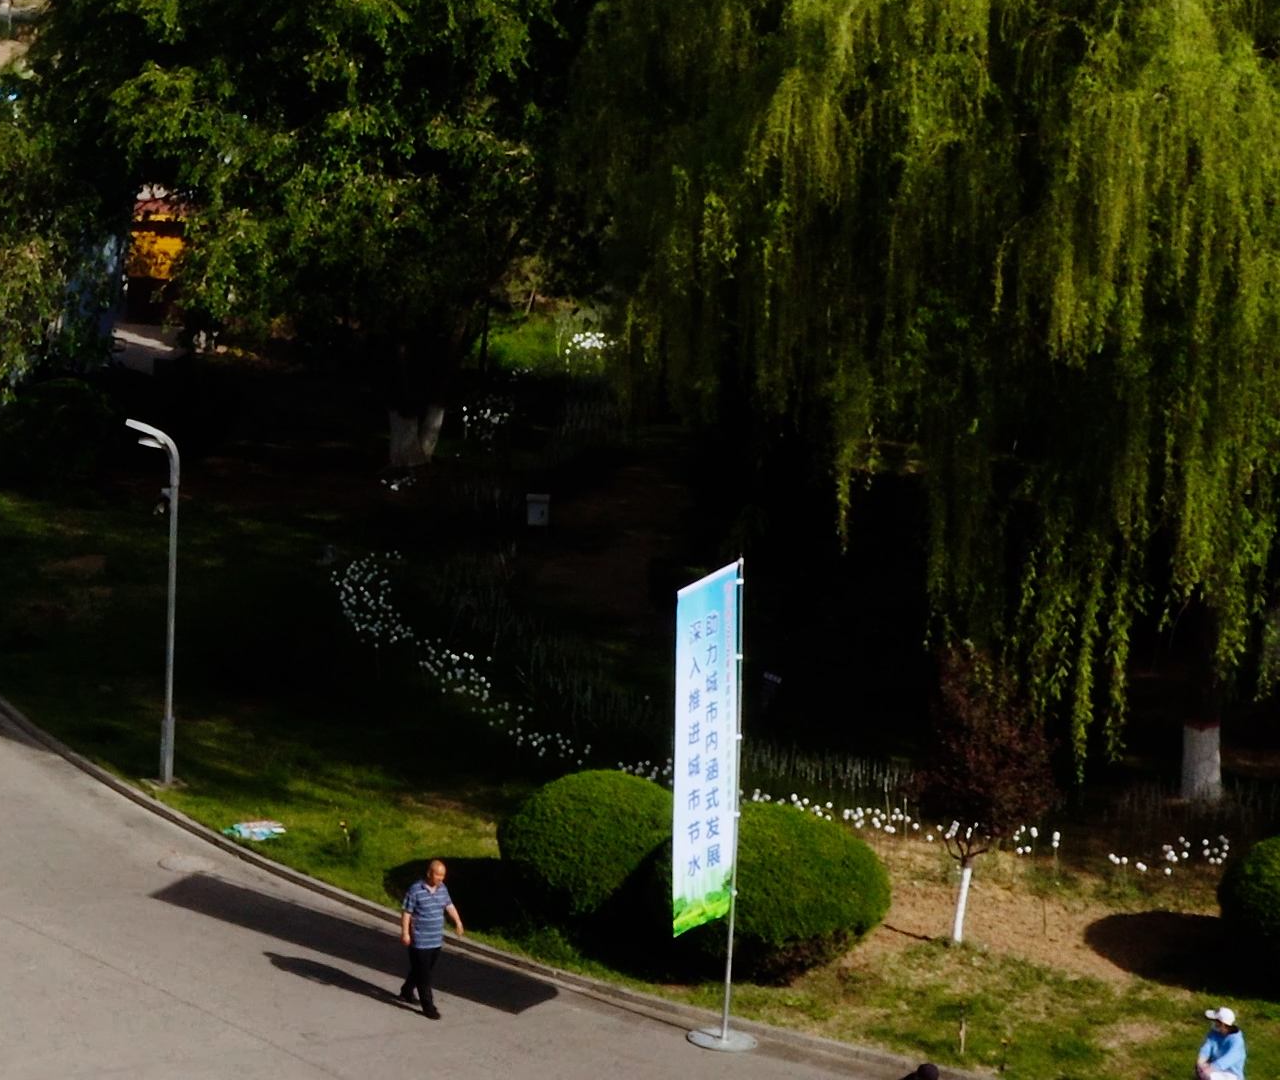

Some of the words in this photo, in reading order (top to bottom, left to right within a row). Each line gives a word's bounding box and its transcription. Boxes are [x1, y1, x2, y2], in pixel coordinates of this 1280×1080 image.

[686, 621, 702, 878] 深入推进城市节水
[703, 614, 721, 867] 助力城市内涵式发展
